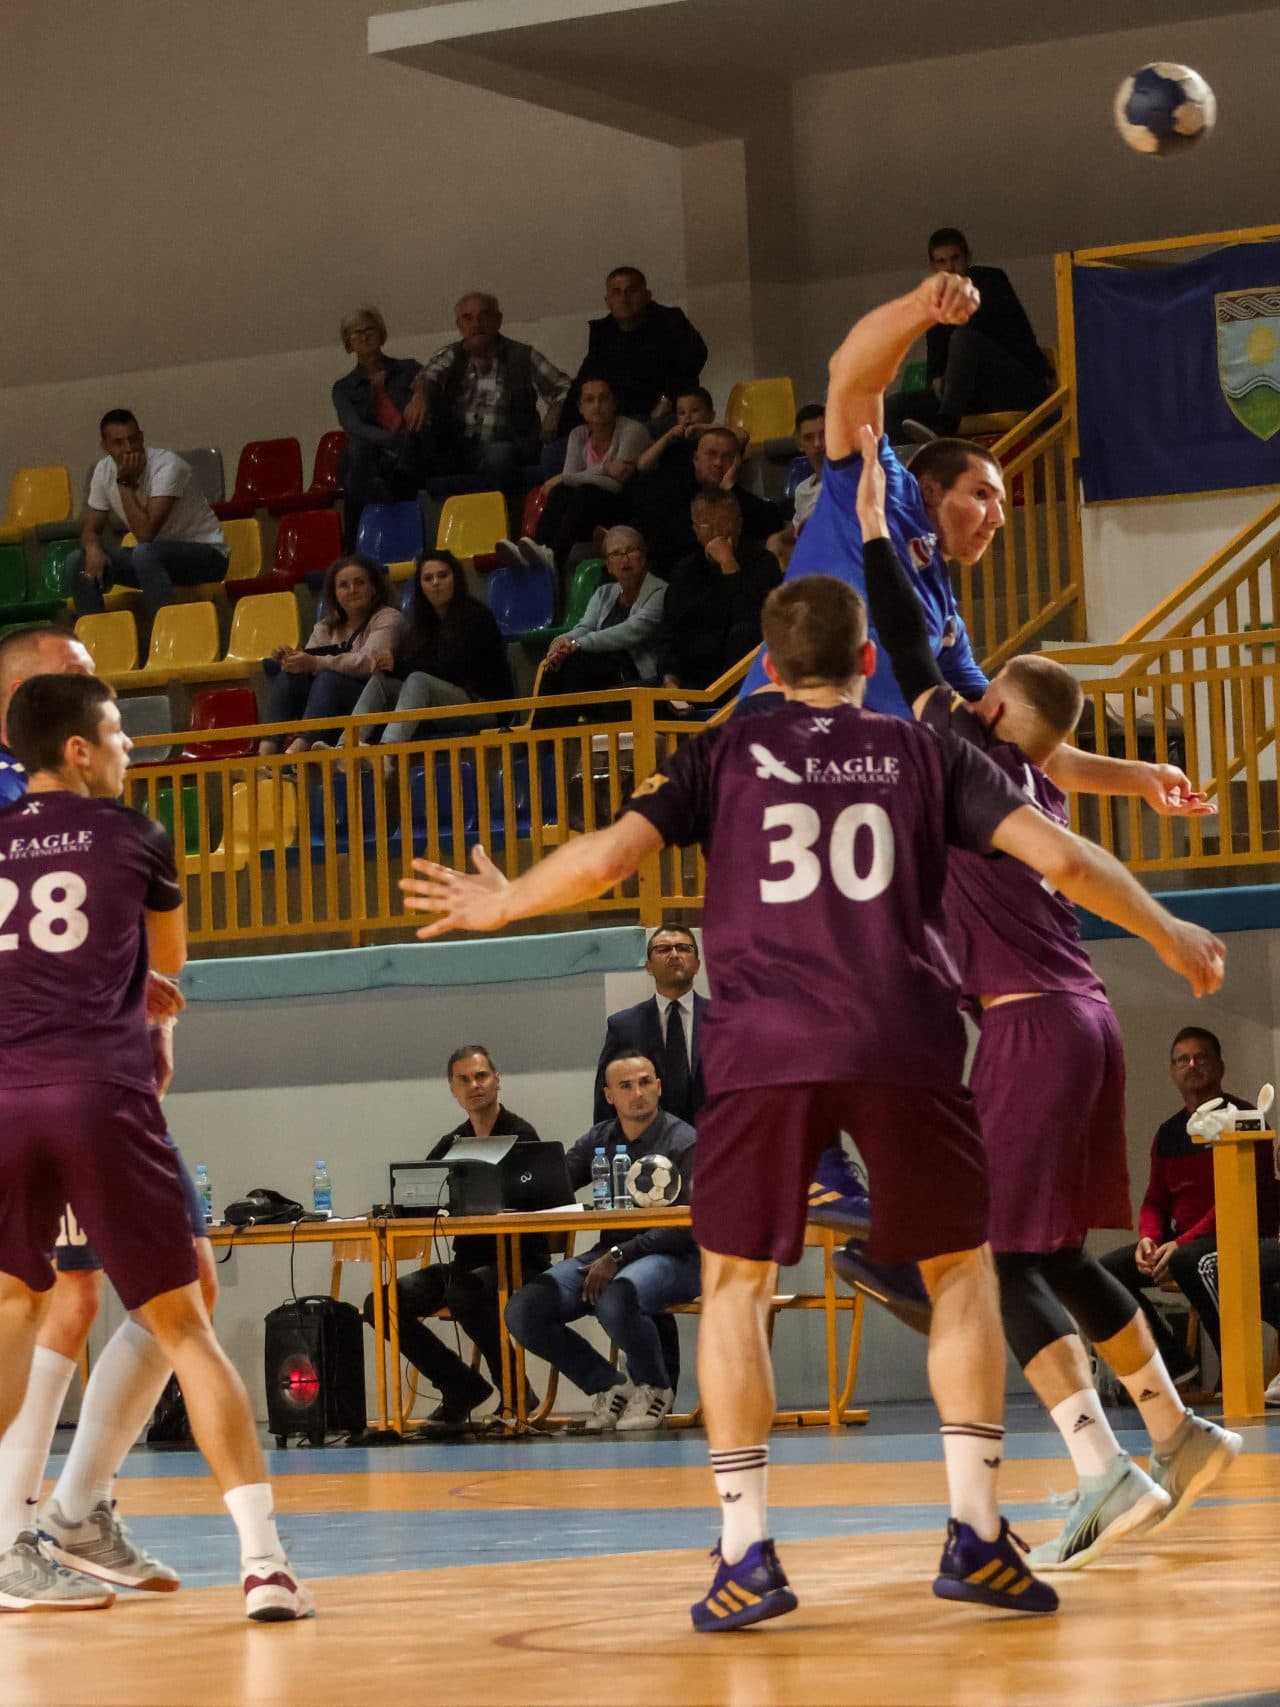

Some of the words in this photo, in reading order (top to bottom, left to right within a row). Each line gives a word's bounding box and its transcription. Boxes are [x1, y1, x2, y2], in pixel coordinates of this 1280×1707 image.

[805, 756, 899, 774] EAGLE
[805, 773, 899, 785] TECHNOLOGY
[10, 830, 93, 853] EAGLE
[760, 802, 895, 903] 30
